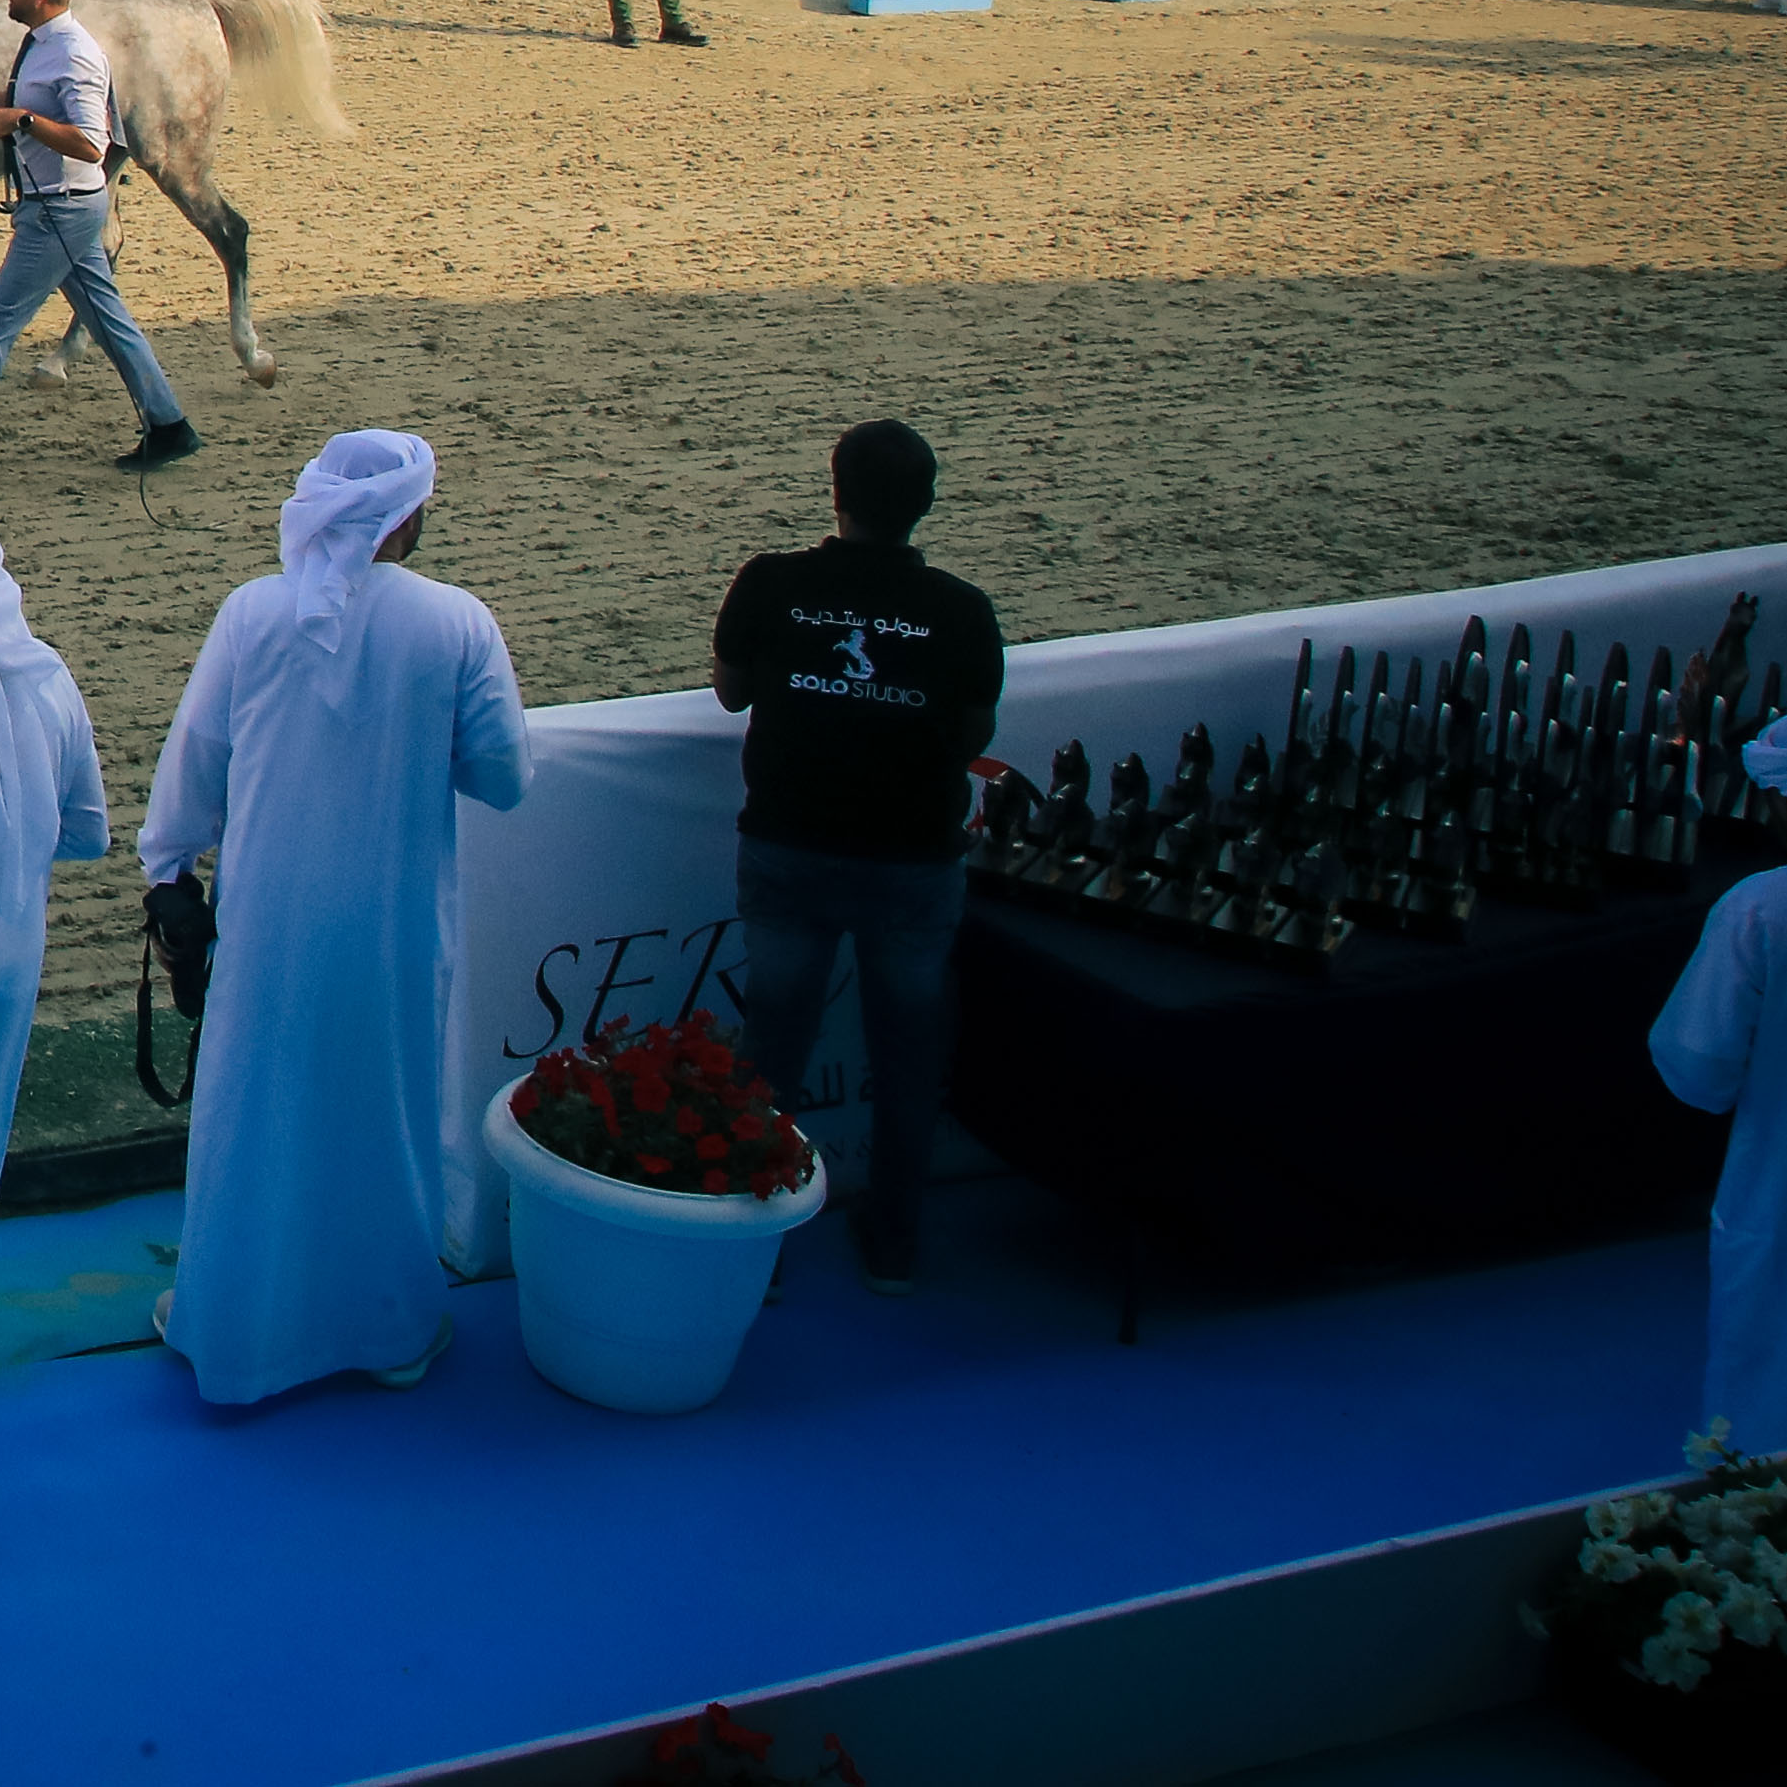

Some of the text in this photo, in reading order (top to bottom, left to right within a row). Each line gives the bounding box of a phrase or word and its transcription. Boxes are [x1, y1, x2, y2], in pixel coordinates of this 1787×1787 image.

[790, 607, 930, 638] سولو ستديو
[789, 673, 926, 707] SOLO STUDIO
[502, 916, 750, 1059] SER
